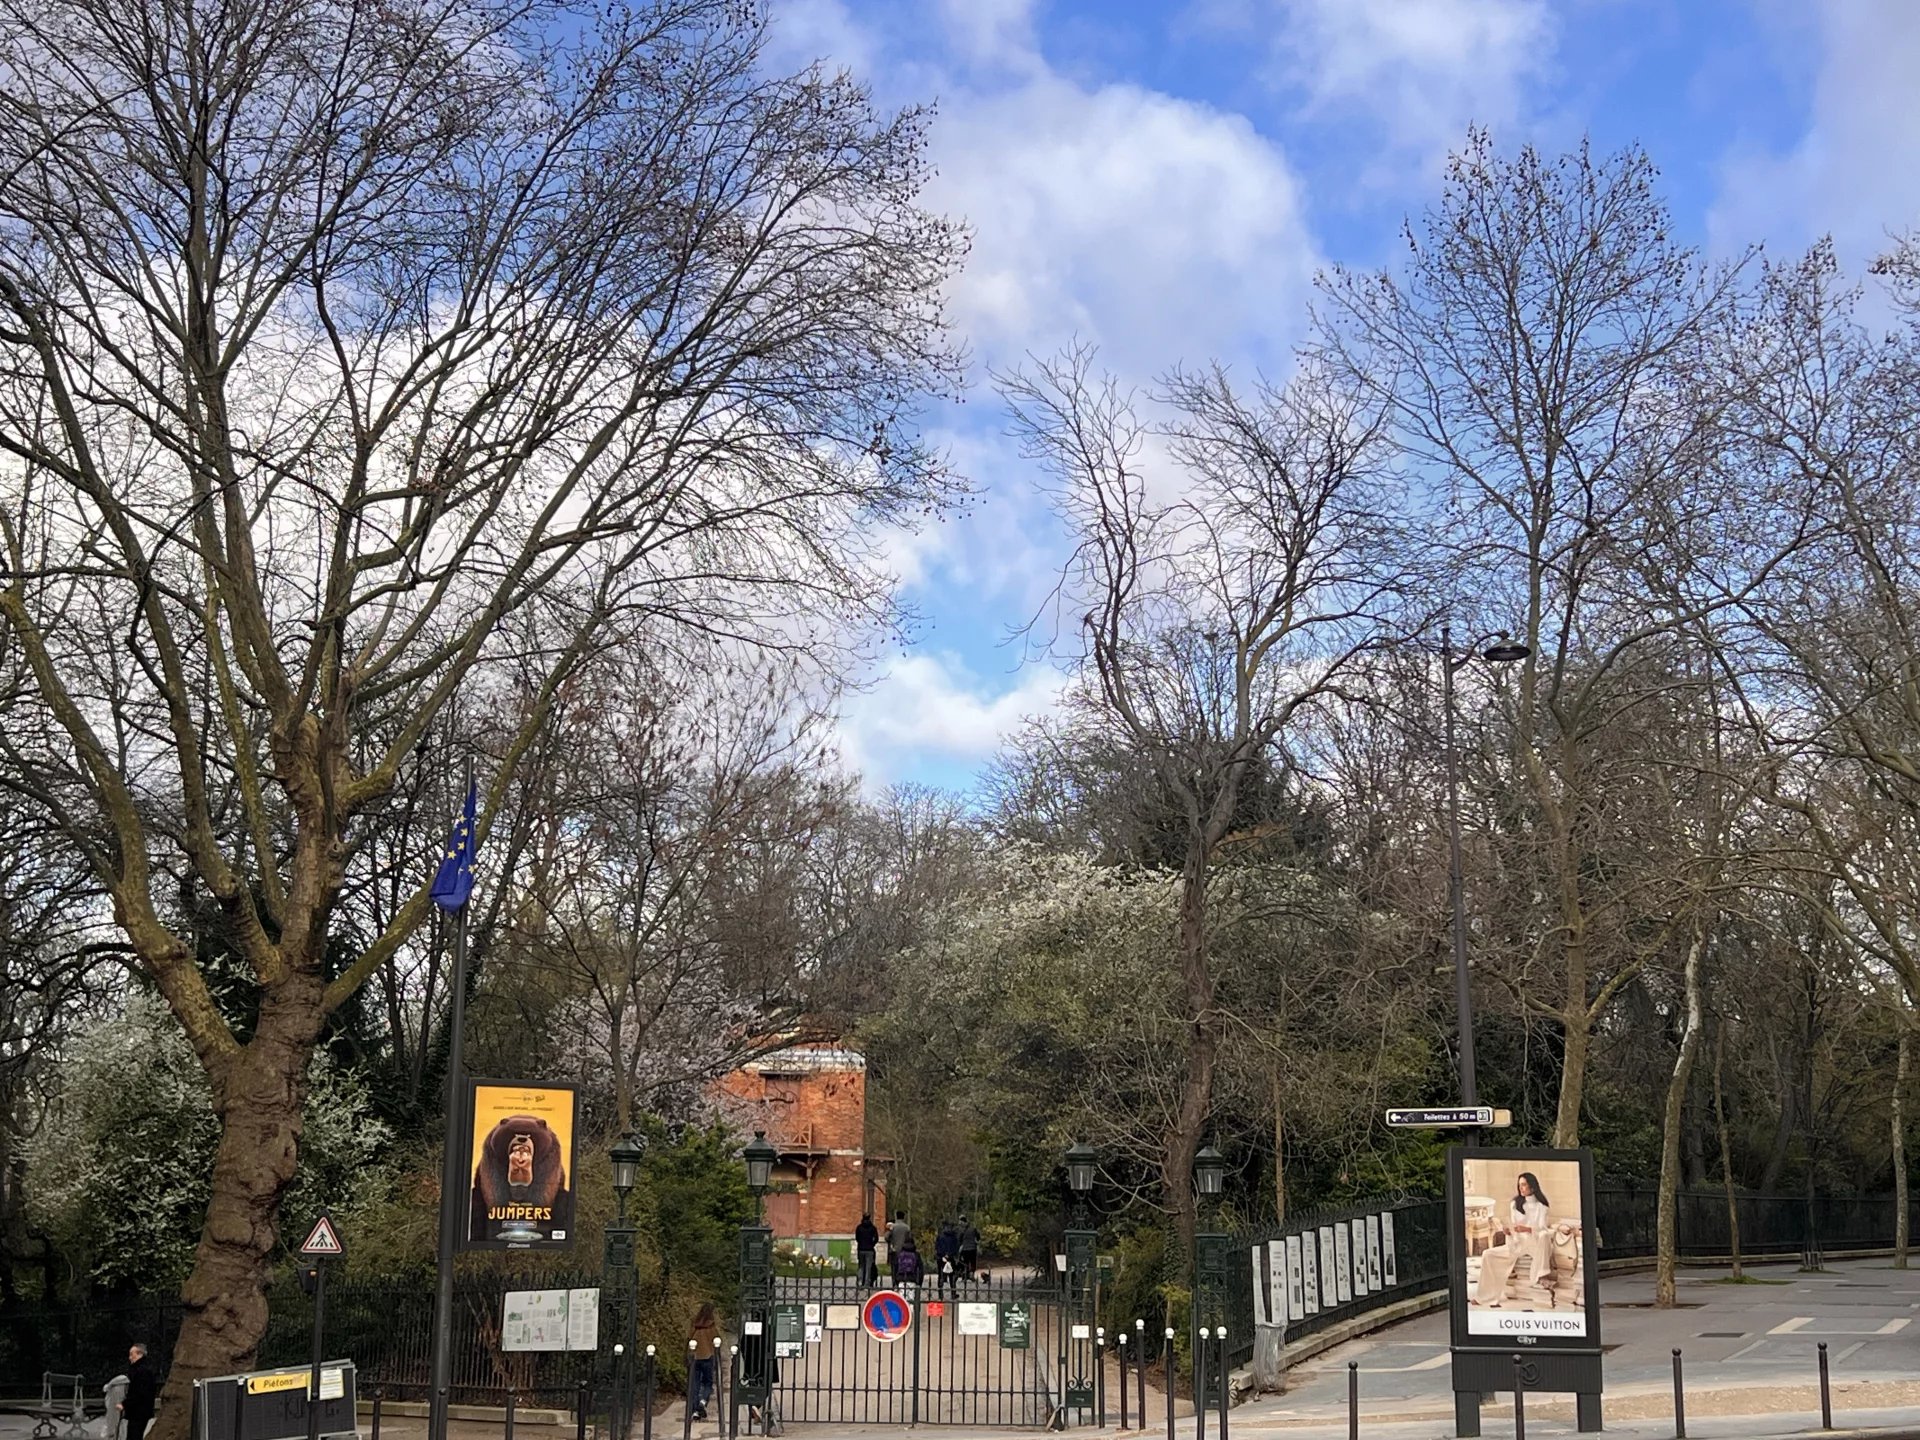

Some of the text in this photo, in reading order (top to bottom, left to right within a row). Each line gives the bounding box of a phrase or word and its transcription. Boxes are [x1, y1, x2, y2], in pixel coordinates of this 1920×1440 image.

[488, 1207, 552, 1220] JUMPERS
[1499, 1319, 1580, 1330] LOUIS VUITTON
[263, 1379, 293, 1388] Piétons
